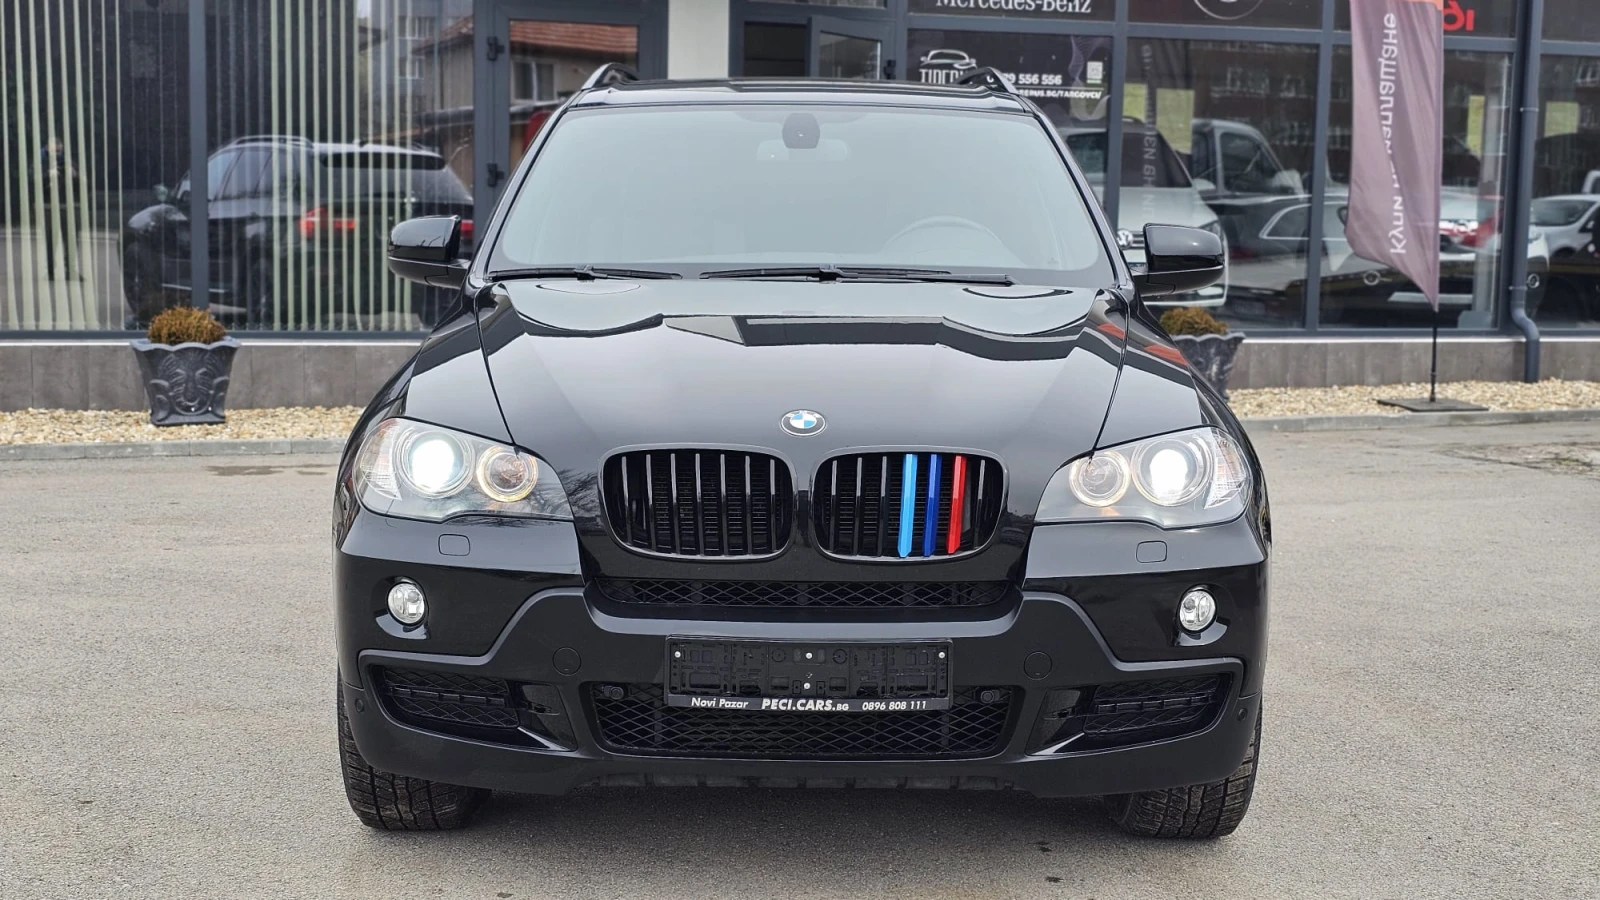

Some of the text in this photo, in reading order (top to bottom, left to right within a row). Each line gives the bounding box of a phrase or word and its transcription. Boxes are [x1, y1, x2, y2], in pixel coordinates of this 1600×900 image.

[1018, 73, 1039, 85] 556
[1041, 74, 1062, 86] 556
[691, 697, 716, 707] Novi
[719, 698, 749, 708] Pazar
[862, 702, 886, 711] 0896
[888, 701, 907, 710] 808
[910, 701, 927, 710] 111
